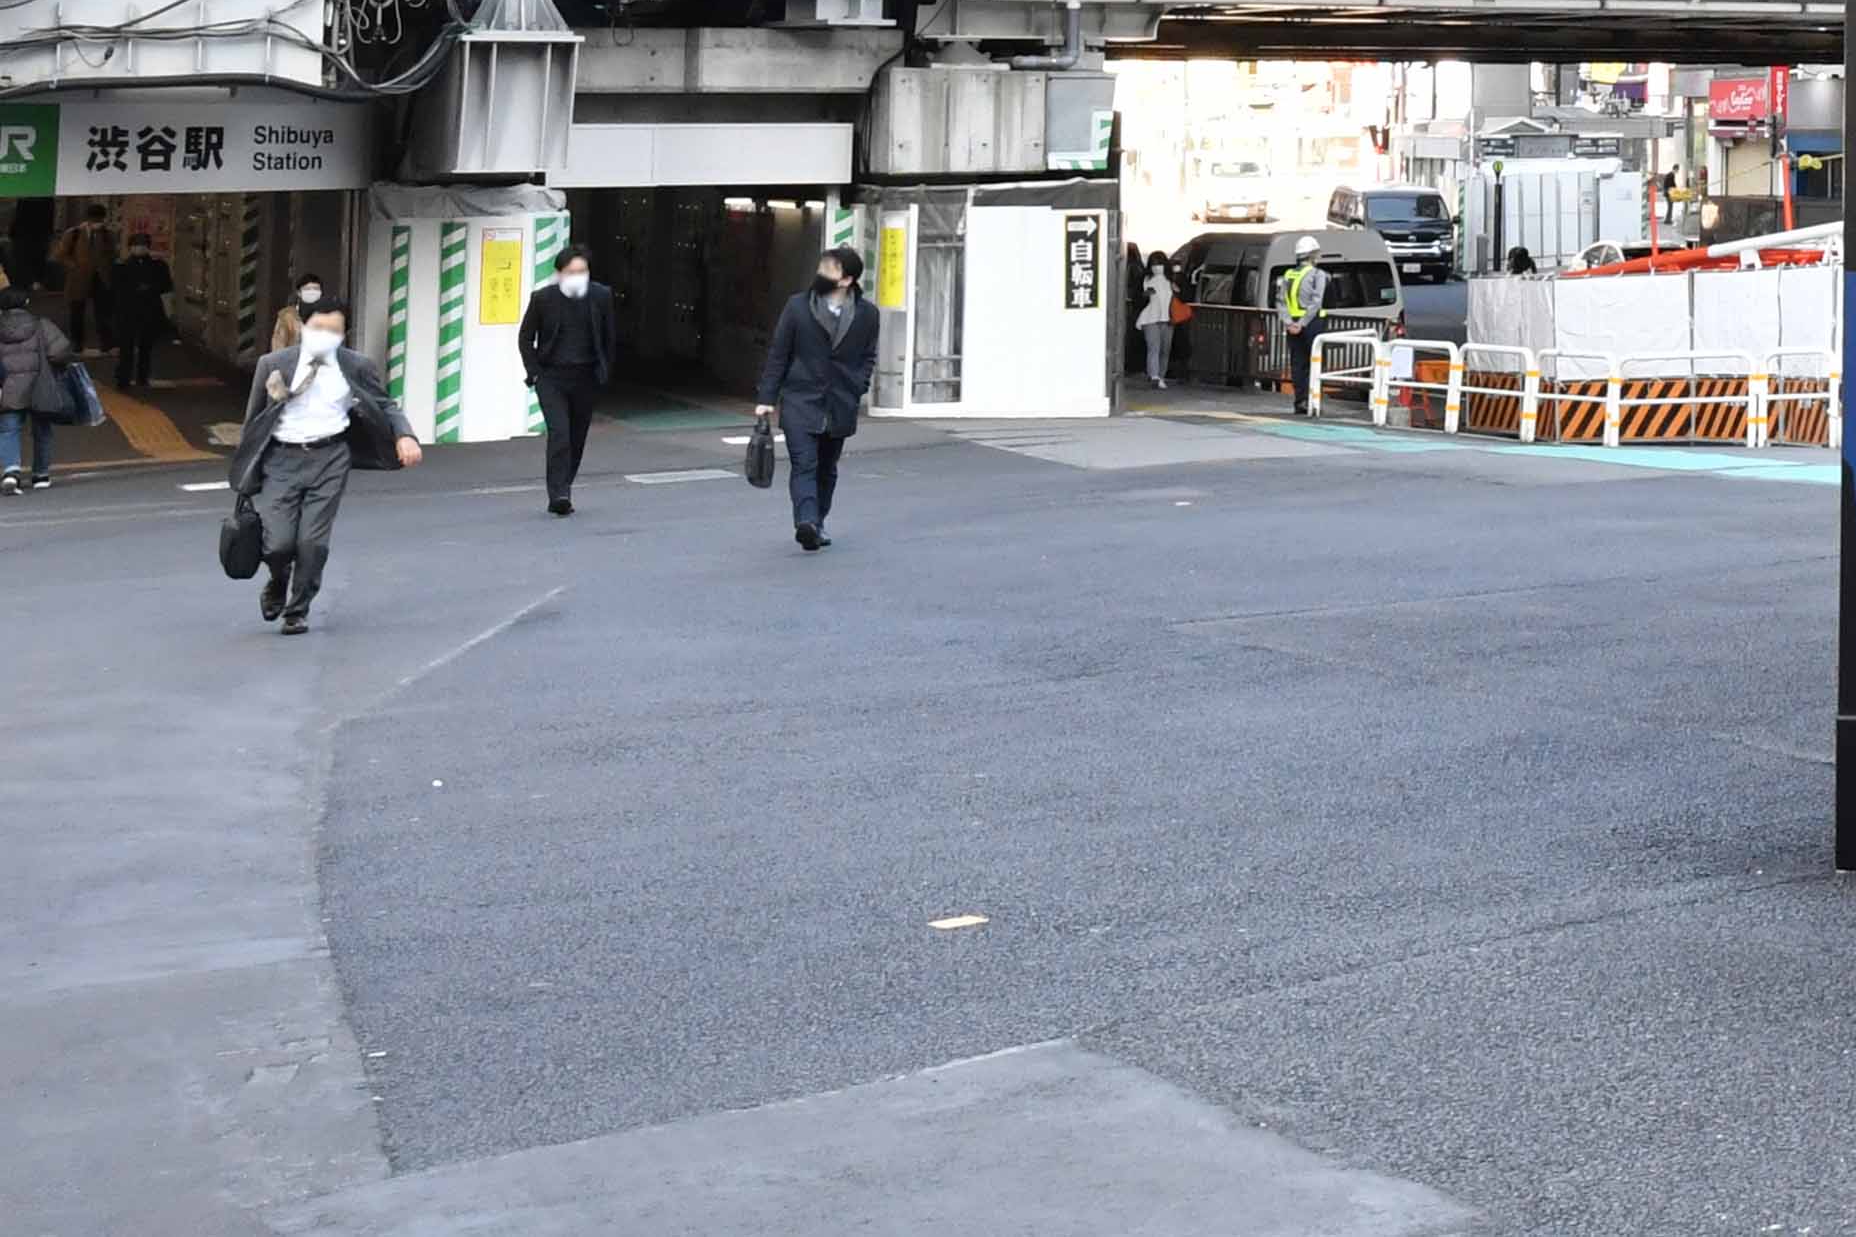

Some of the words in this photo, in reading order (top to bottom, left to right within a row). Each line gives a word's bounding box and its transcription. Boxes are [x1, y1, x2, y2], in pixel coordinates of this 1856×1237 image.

[86, 125, 225, 173] 渋谷駅
[253, 125, 335, 149] Shibuya
[252, 151, 323, 172] Station
[1070, 238, 1094, 309] 自転車
